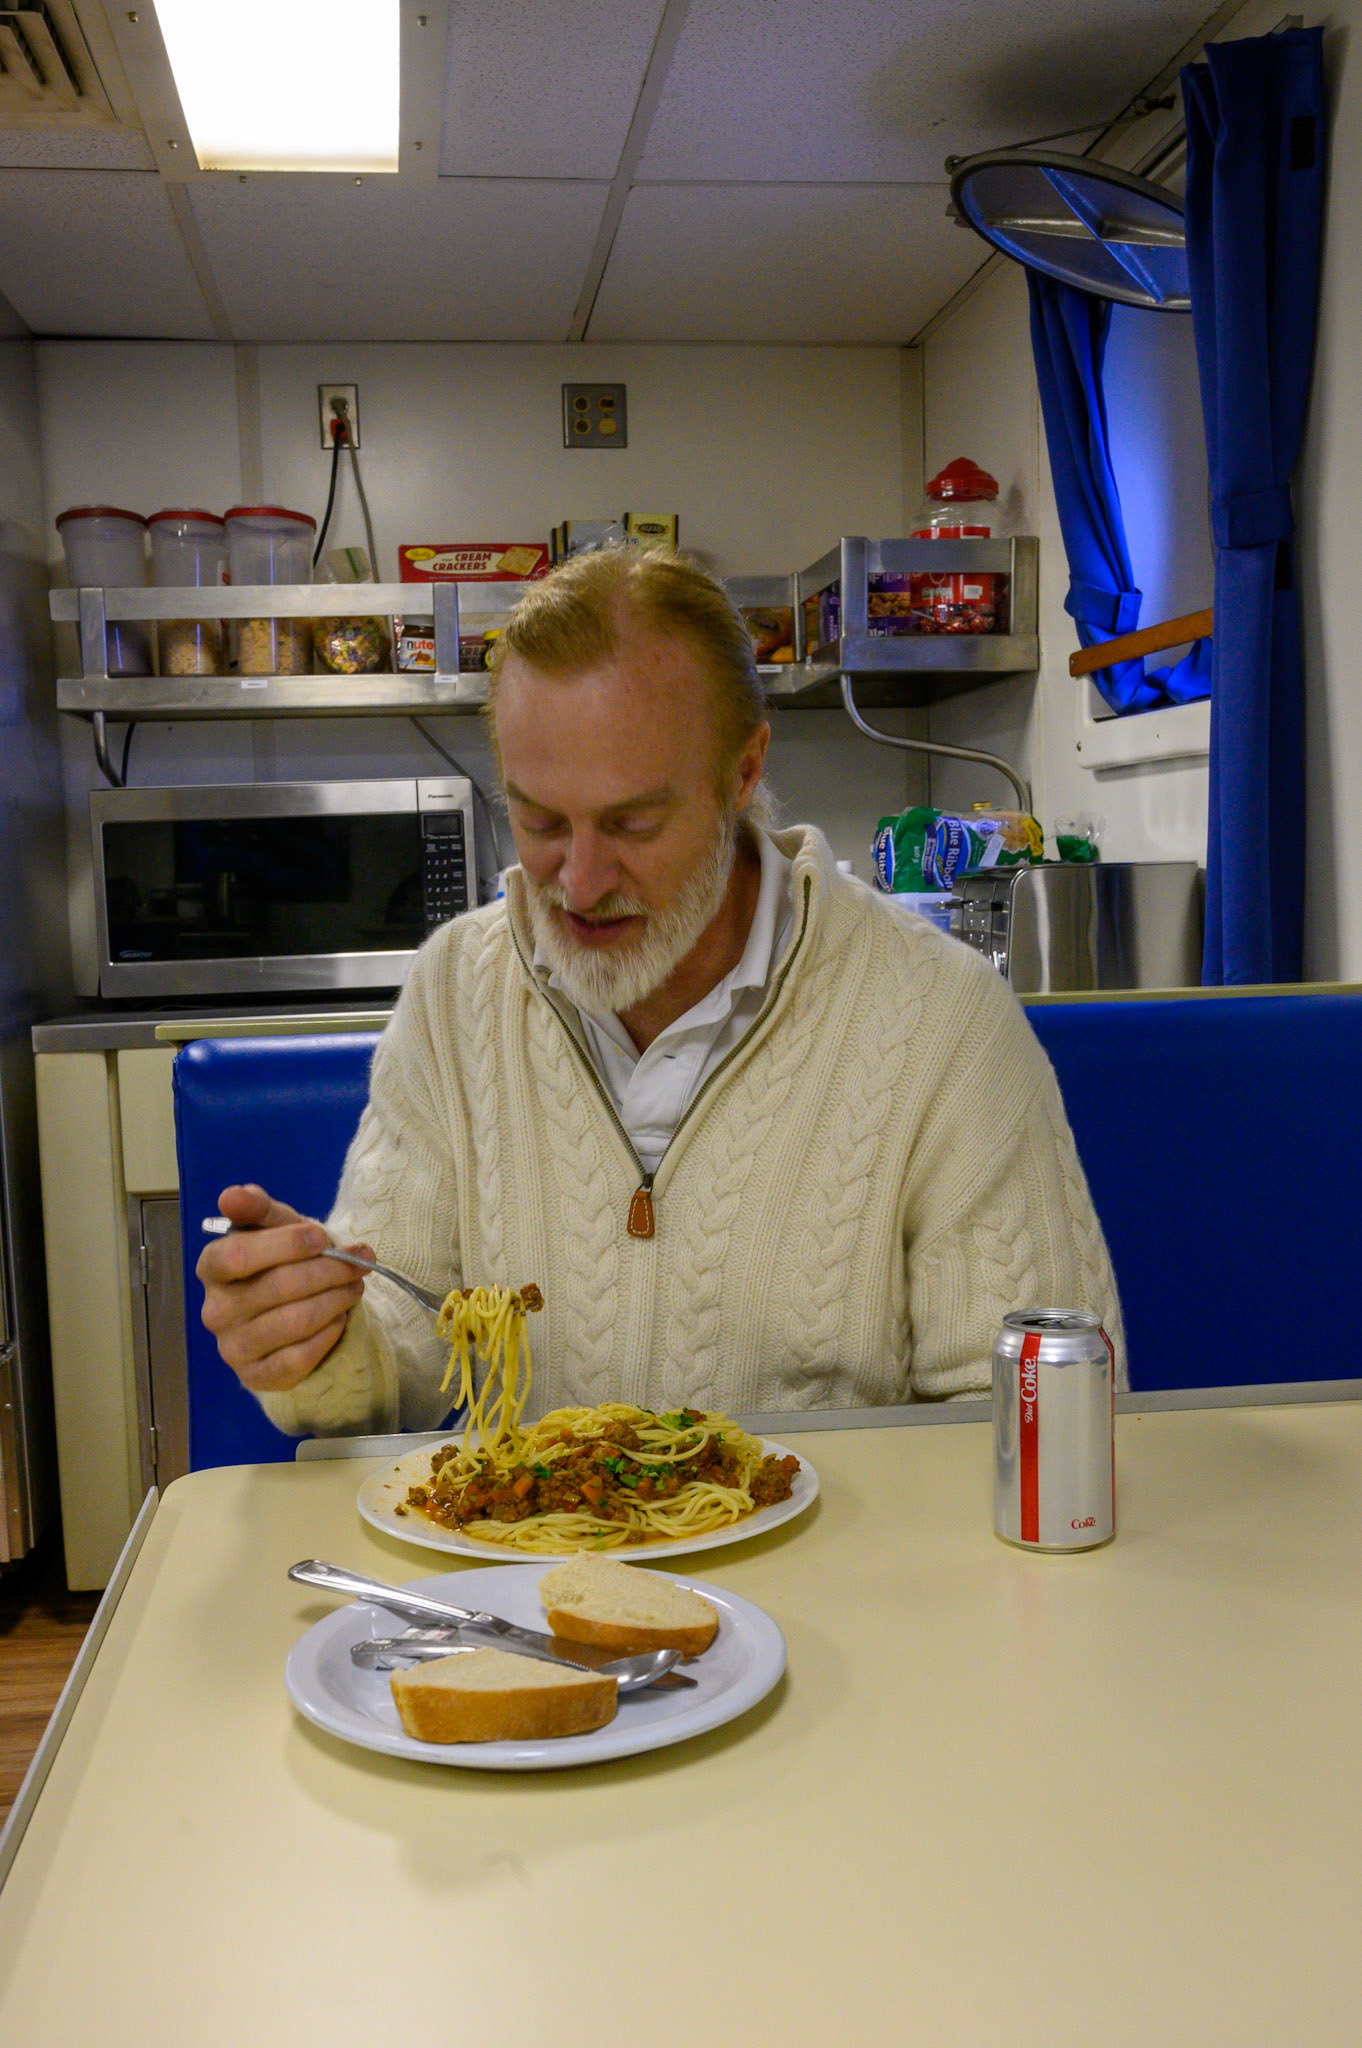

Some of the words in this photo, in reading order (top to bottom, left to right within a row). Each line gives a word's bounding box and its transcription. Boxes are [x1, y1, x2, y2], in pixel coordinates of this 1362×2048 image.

[454, 552, 492, 562] CREAM
[432, 562, 487, 571] CRACKERS
[407, 640, 435, 651] nute
[947, 820, 962, 845] Blue
[942, 848, 960, 889] Ribbon
[1021, 1358, 1037, 1402] Coke
[1071, 1517, 1097, 1529] Coke
